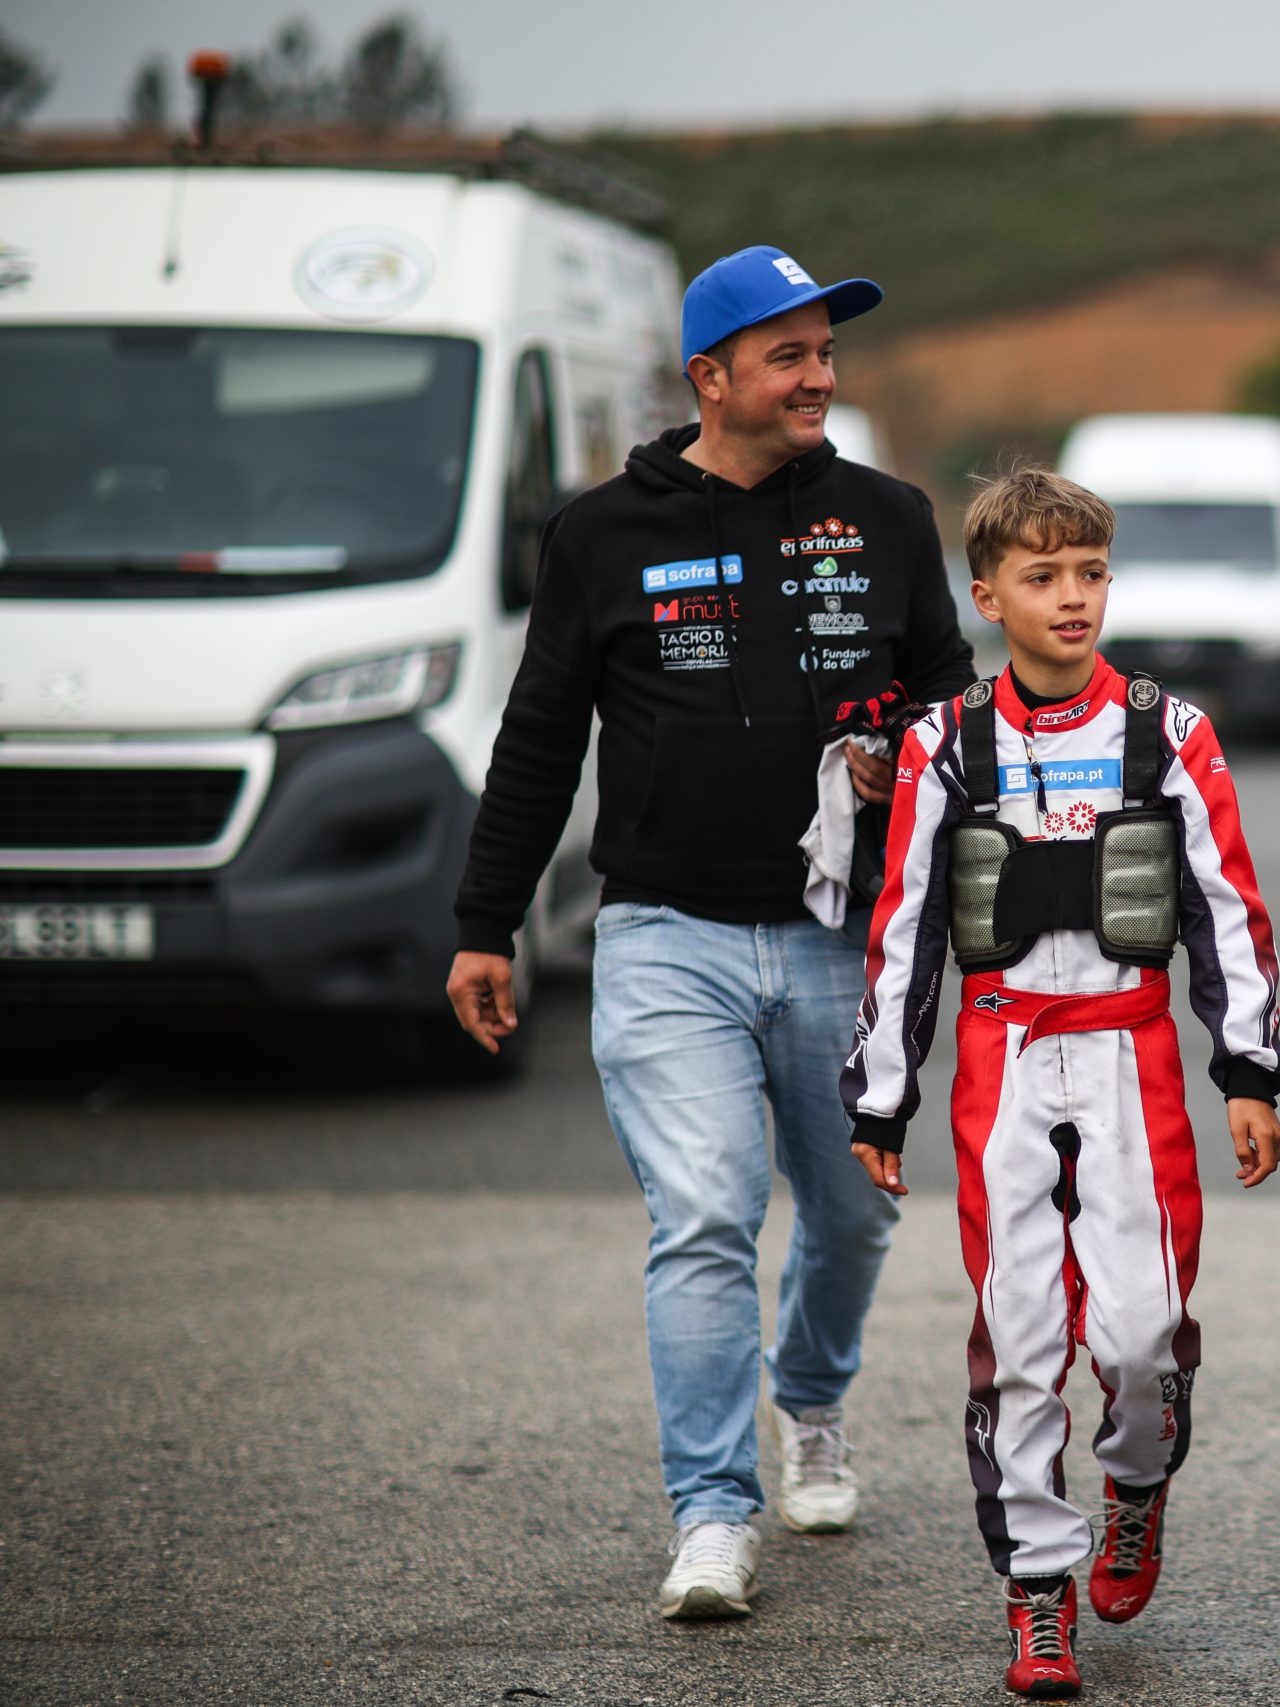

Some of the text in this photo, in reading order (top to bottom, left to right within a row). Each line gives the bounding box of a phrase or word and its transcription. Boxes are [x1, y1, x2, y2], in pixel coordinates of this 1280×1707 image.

[683, 600, 740, 620] mut
[659, 630, 712, 646] TACHO
[822, 648, 871, 661] Fundação
[823, 659, 838, 669] do
